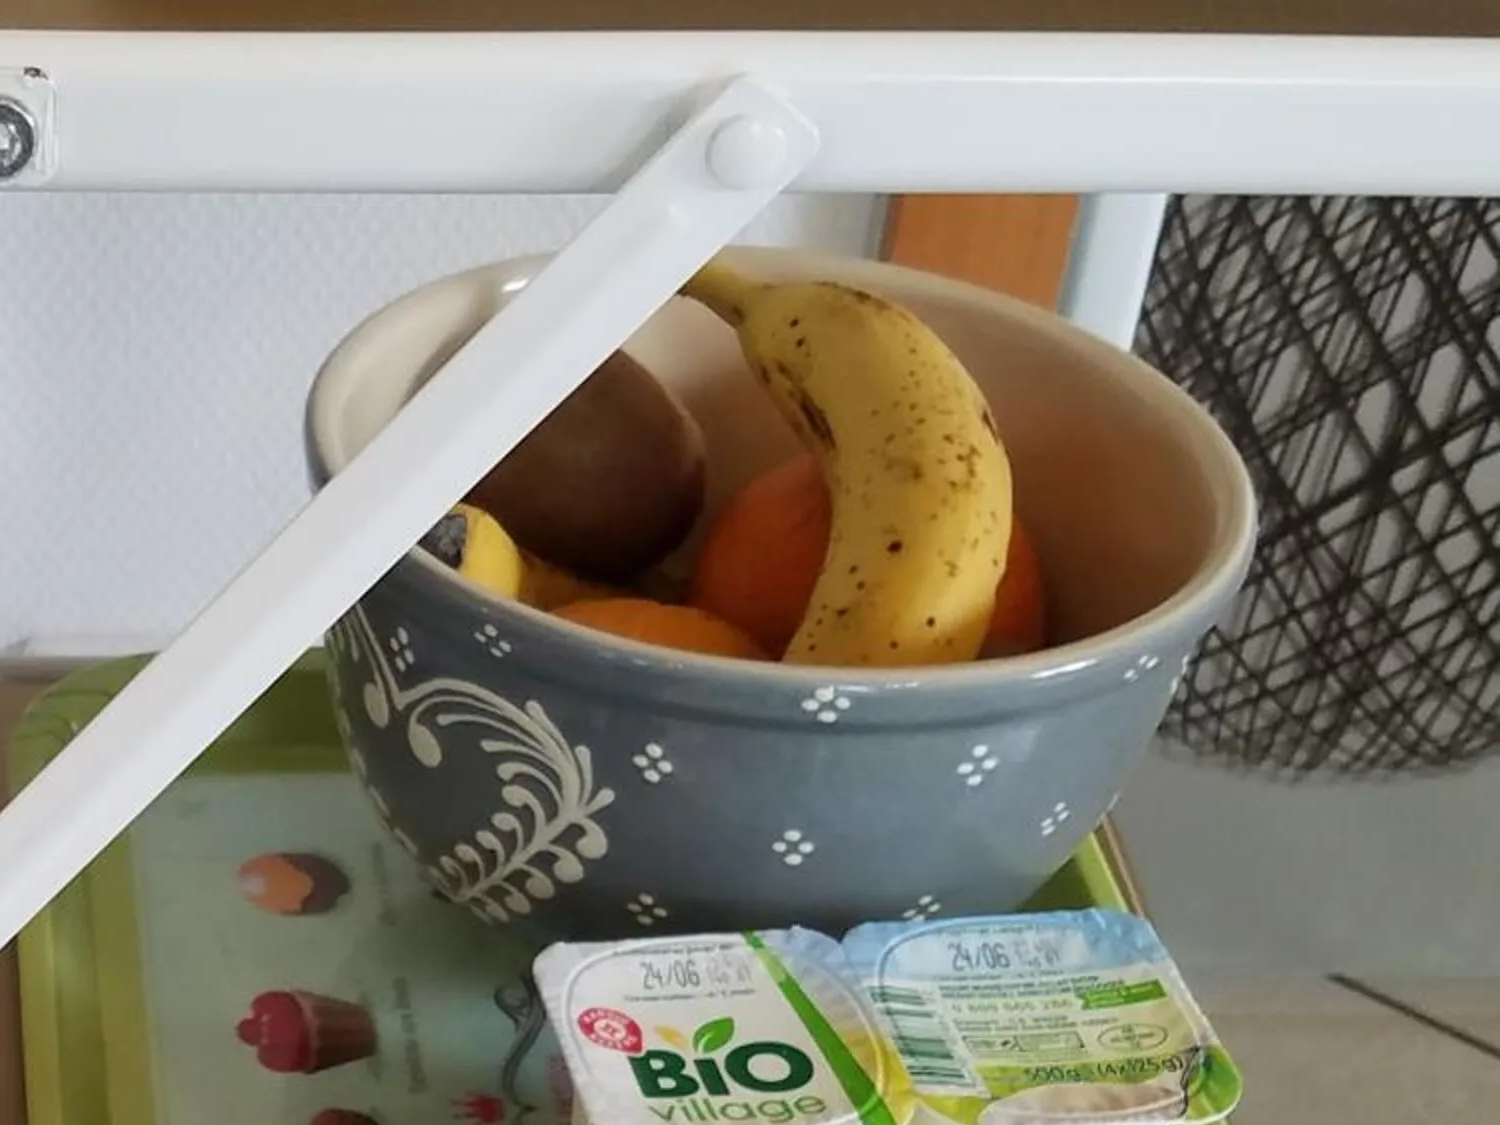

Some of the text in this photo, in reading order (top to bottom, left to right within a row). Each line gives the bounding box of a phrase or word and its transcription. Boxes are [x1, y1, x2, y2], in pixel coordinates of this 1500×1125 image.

[947, 942, 1010, 971] 24/06
[639, 959, 701, 989] 24/06
[650, 1096, 827, 1124] village
